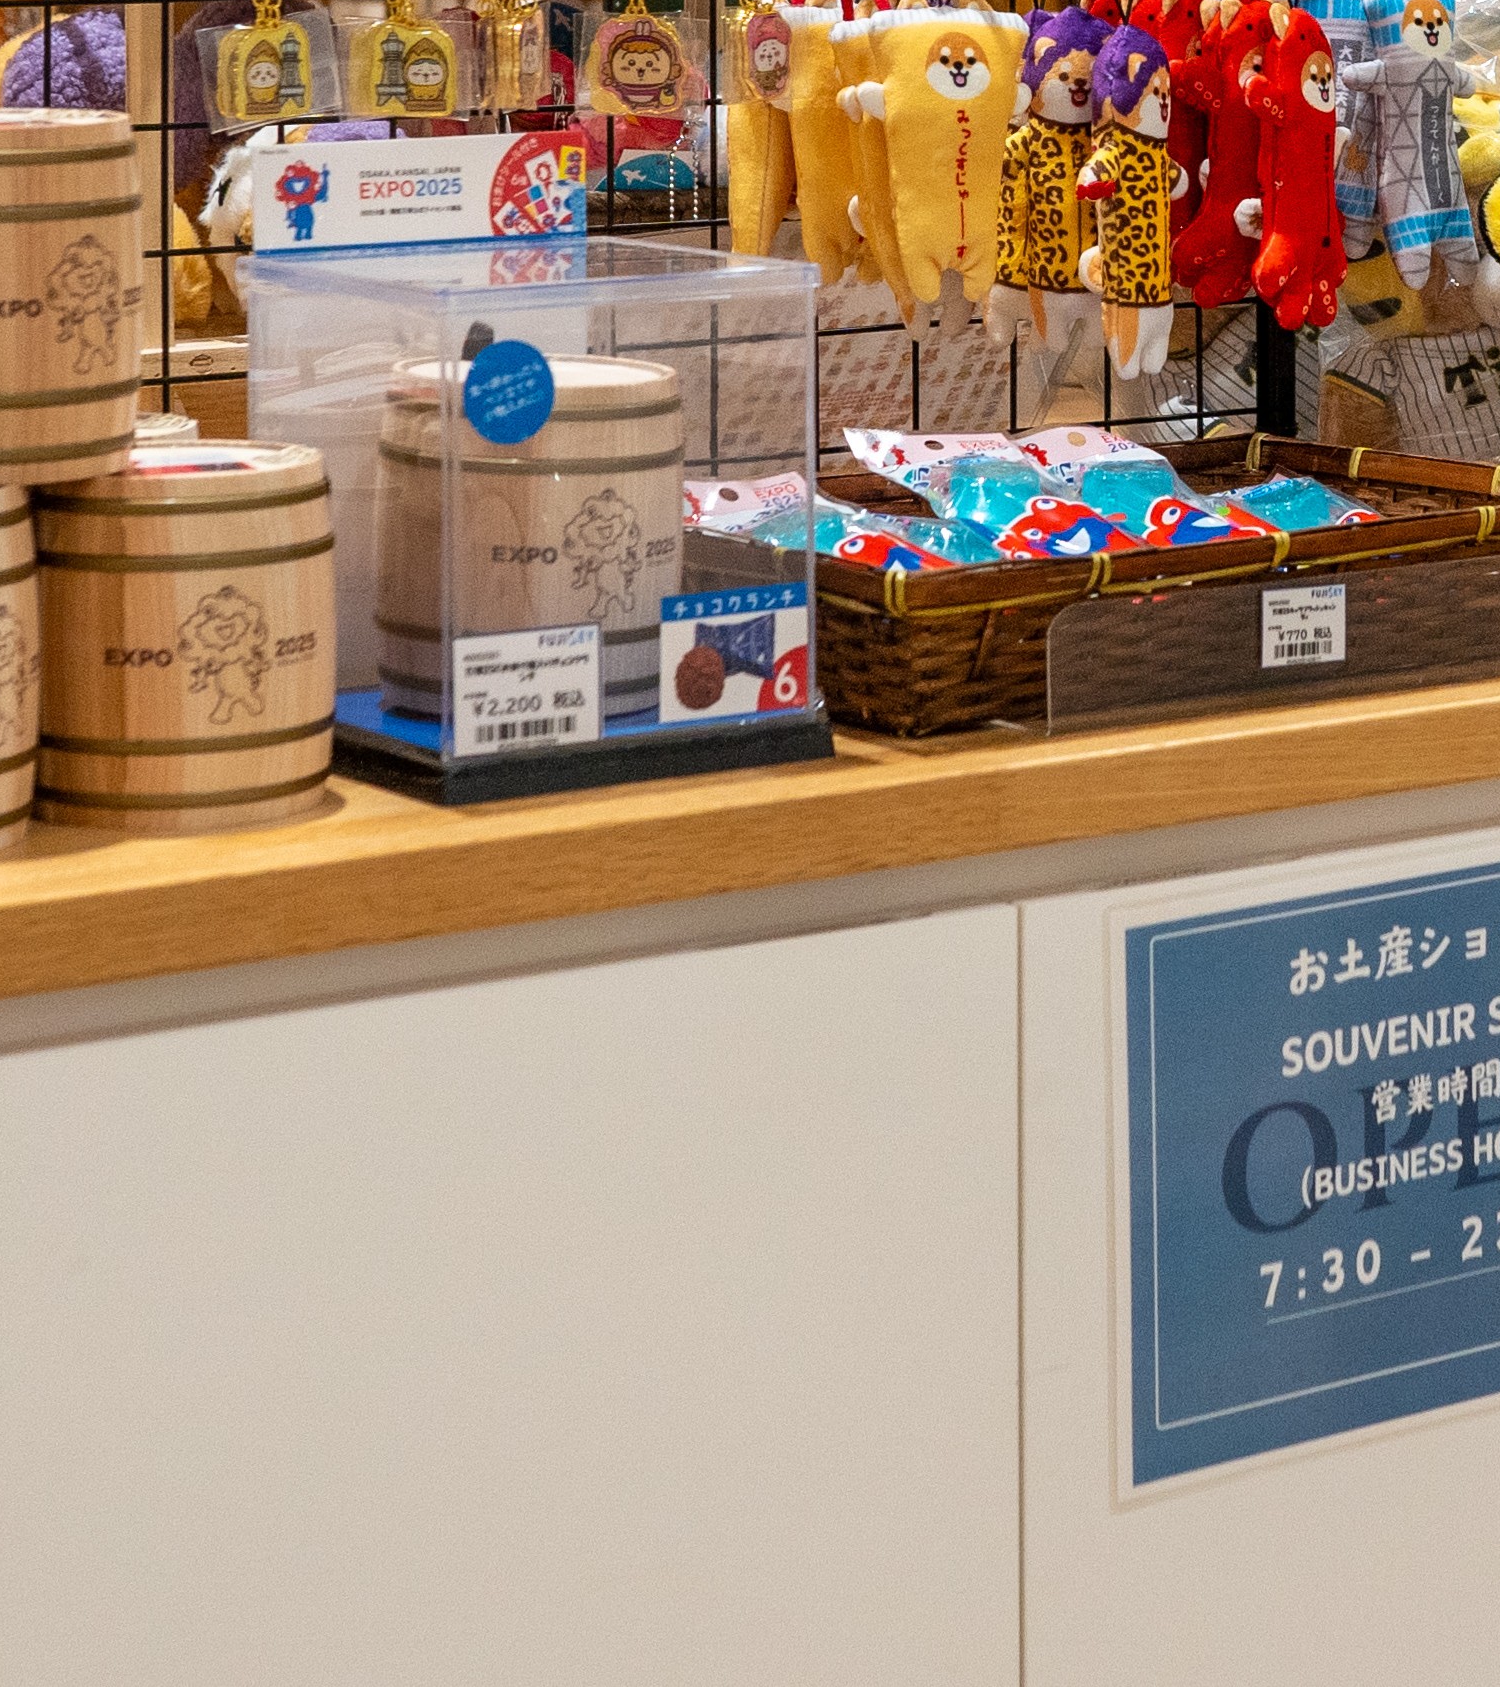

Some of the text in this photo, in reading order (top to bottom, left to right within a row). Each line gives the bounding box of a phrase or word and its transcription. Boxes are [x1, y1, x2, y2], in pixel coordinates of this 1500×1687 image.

[359, 178, 463, 200] EXPO2025
[754, 484, 798, 499] EXPO
[491, 546, 559, 564] EXPO
[674, 589, 796, 619] チョコクランチ
[106, 633, 318, 667] EXPO 2025
[1279, 629, 1308, 641] ¥770
[773, 662, 798, 704] 6
[1282, 1002, 1476, 1078] SOUVENIR
[1300, 1138, 1464, 1209] (BUSINESS
[1260, 1239, 1383, 1310] 7:30
